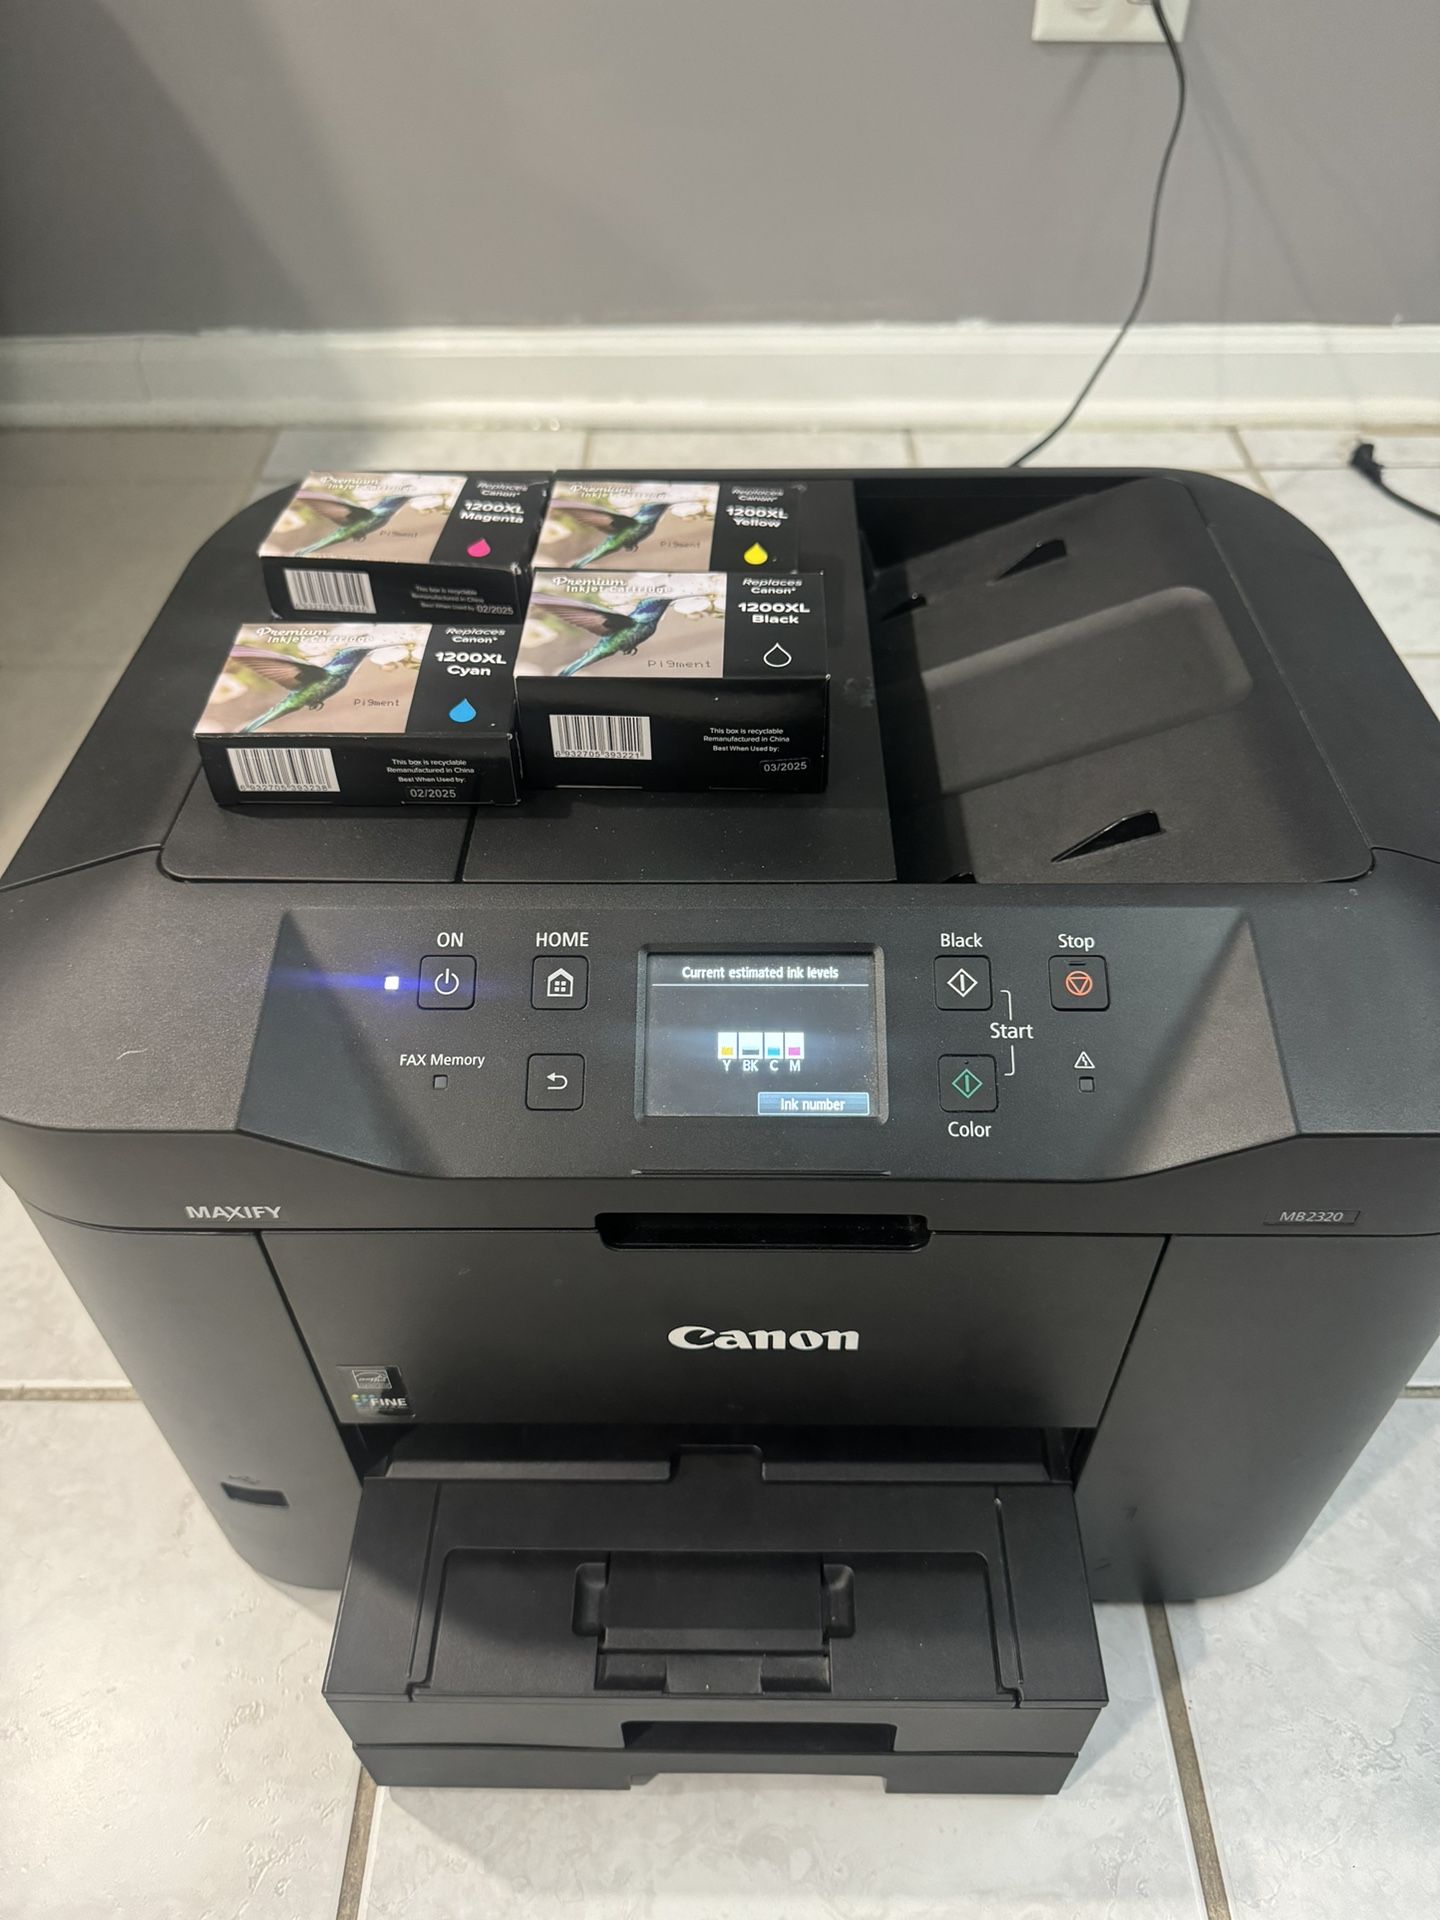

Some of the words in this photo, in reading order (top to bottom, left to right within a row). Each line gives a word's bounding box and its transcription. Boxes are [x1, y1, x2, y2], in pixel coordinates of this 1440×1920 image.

[464, 500, 525, 515] 1200XL
[726, 505, 789, 519] 1200XL
[459, 510, 524, 524] Magenta
[733, 517, 781, 528] Yellow
[553, 576, 626, 588] Premium
[742, 577, 803, 587] Replaces
[566, 584, 603, 594] Inkjet
[476, 605, 514, 616] 02/2025
[738, 602, 811, 614] 1200XL
[752, 614, 800, 624] Black
[256, 627, 328, 636] Premium
[445, 627, 506, 636] Replaces
[434, 651, 507, 665] 1200XL
[647, 659, 712, 669] Pigment
[446, 665, 491, 677] Cyan
[353, 699, 401, 708] Pigment
[710, 727, 725, 735] This
[748, 728, 784, 736] recyclable
[703, 735, 760, 743] Remanufactured
[392, 758, 407, 766] This
[763, 761, 808, 772] 03/2025
[410, 788, 457, 799] 02/2025
[436, 932, 464, 948] ON
[535, 932, 590, 948] HOME
[940, 933, 983, 949] Black
[1058, 934, 1095, 952] Stop
[681, 966, 725, 980] Current
[728, 966, 784, 980] estimated
[787, 966, 804, 980] ink
[807, 966, 840, 980] levels
[989, 1022, 1034, 1040] Start
[400, 1054, 427, 1067] FAX
[430, 1054, 486, 1069] Memory
[722, 1059, 732, 1072] Y
[742, 1059, 759, 1072] BK
[769, 1059, 779, 1072] C
[789, 1059, 801, 1072] M
[780, 1098, 799, 1112] Ink
[802, 1098, 846, 1112] number
[948, 1121, 992, 1138] Color
[185, 1206, 283, 1222] MAXIFY
[1280, 1211, 1344, 1222] MB2320
[667, 1325, 860, 1351] Canon
[370, 1397, 408, 1407] FINE
